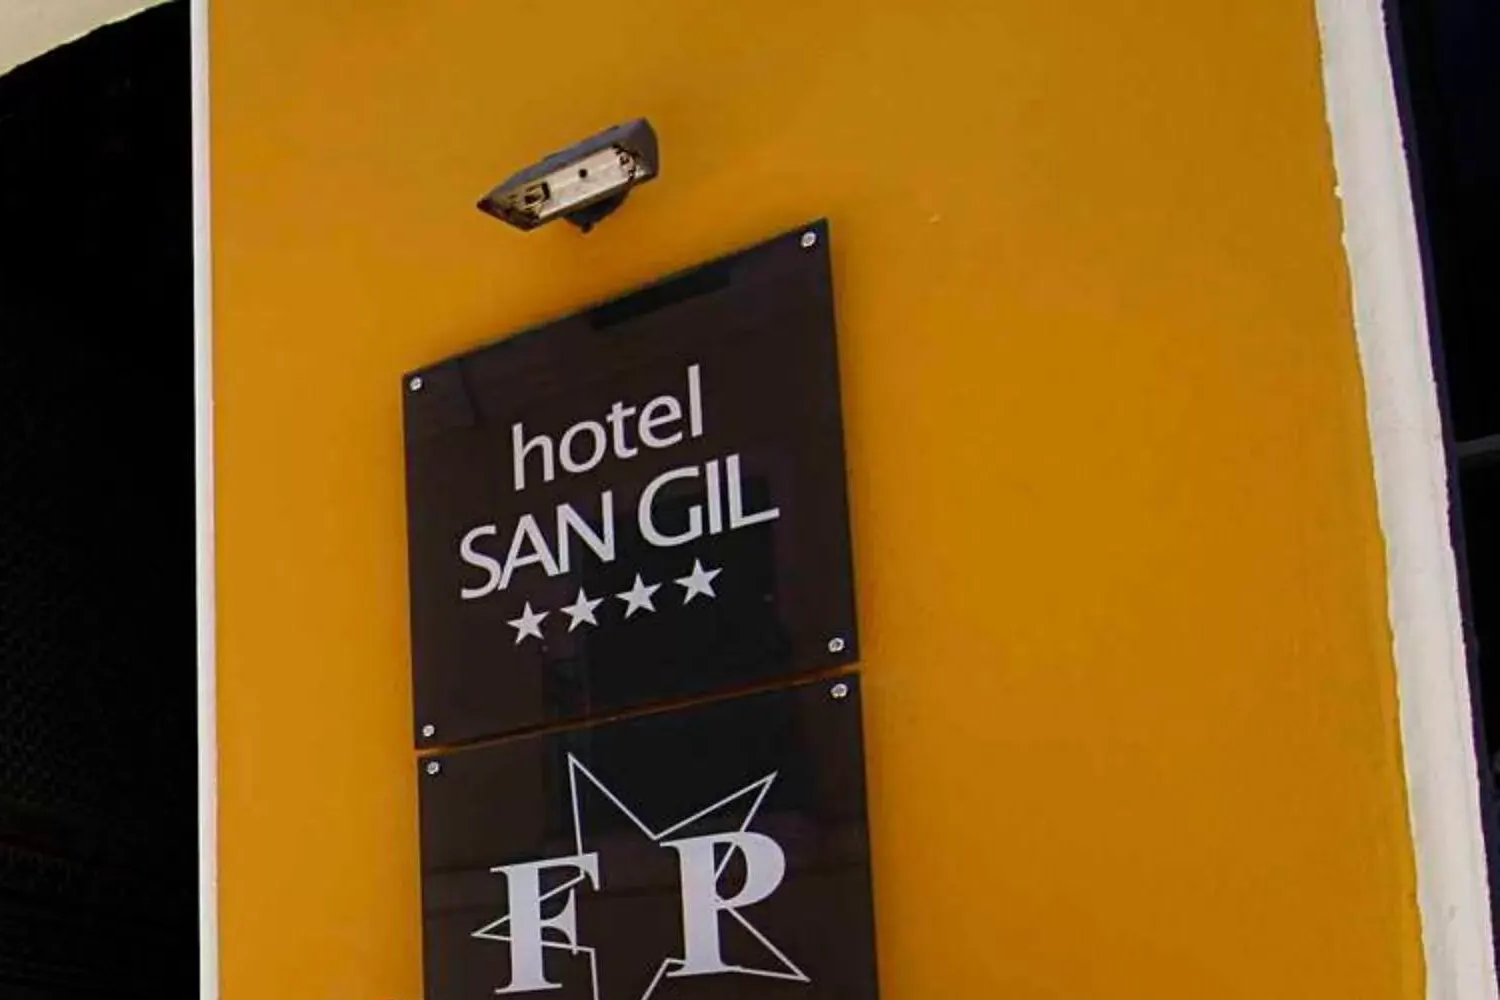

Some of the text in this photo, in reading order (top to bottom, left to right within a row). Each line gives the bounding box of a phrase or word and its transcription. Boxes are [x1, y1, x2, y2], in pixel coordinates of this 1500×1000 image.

[512, 363, 703, 491] hotel
[460, 453, 781, 600] SAN GIL
